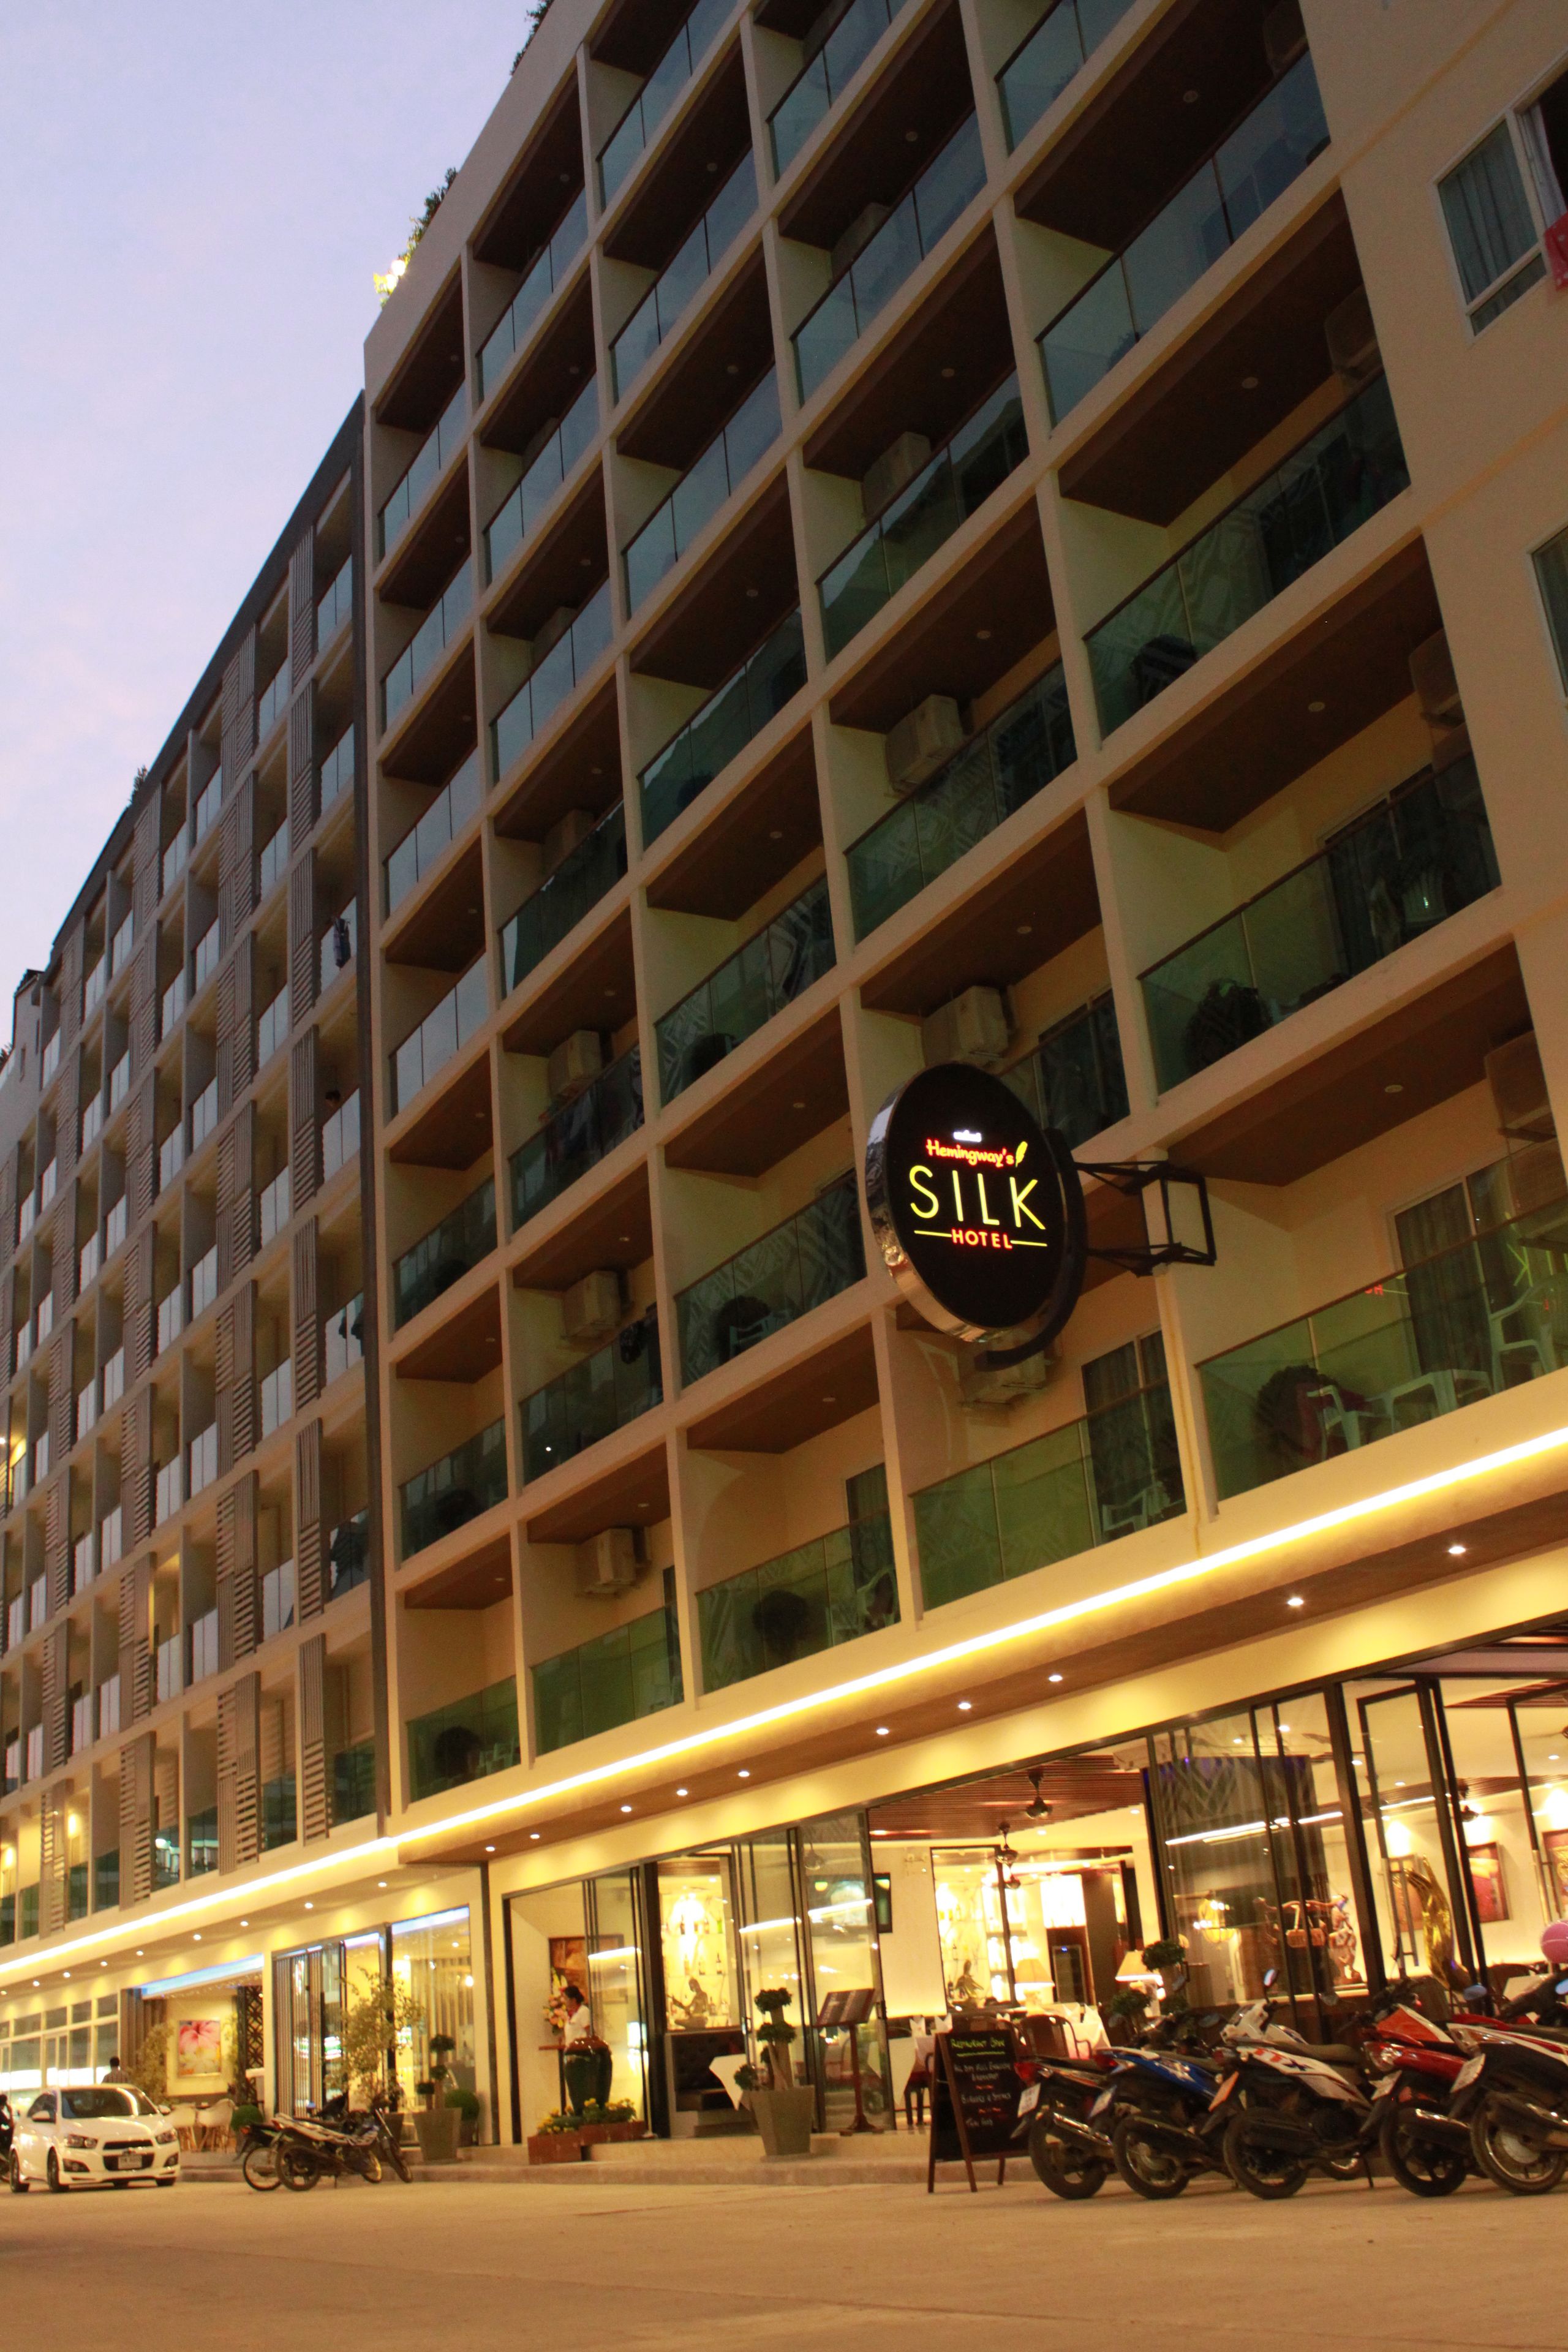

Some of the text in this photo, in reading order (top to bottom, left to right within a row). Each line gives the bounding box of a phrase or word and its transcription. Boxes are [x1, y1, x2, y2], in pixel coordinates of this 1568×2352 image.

[925, 1138, 1015, 1167] Hemingway's
[909, 1165, 1046, 1230] SILK
[951, 1228, 1013, 1249] HOTEL
